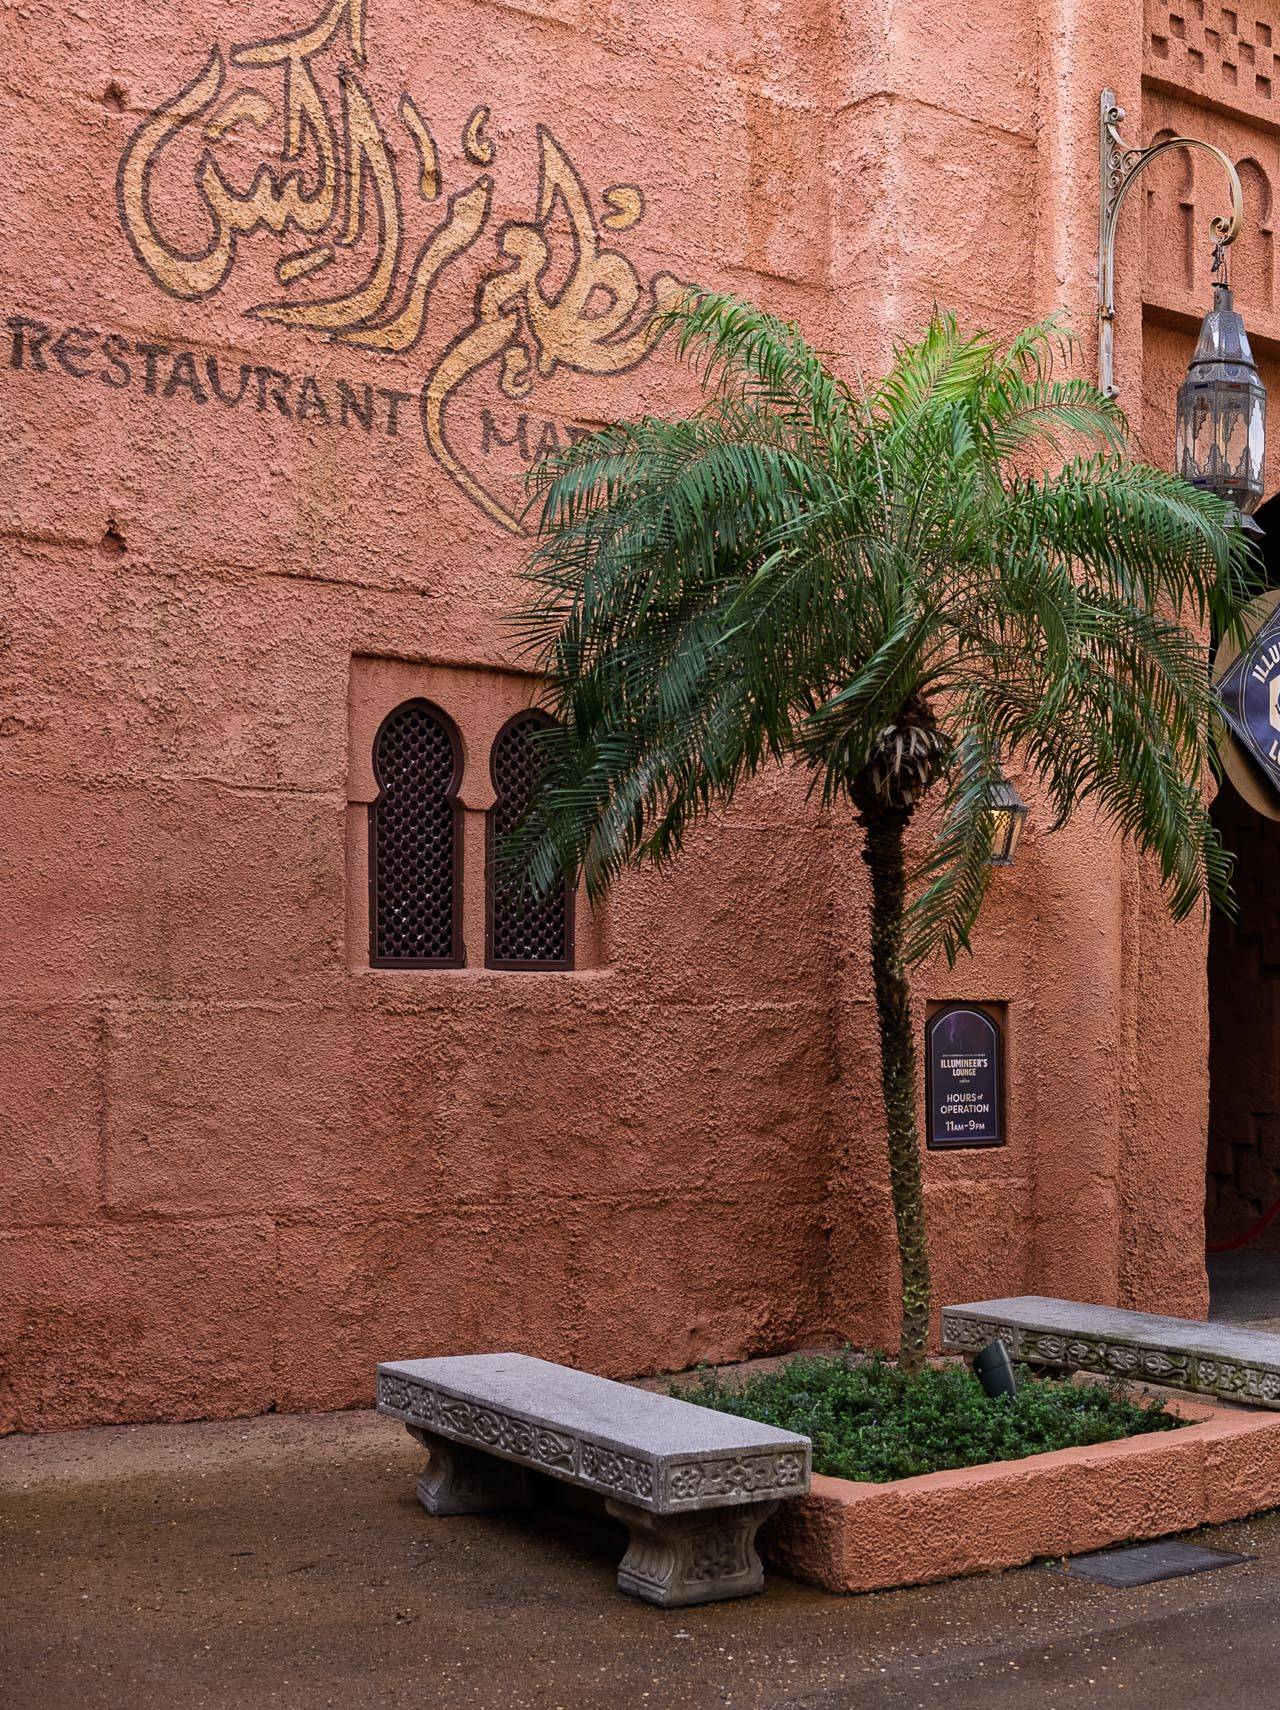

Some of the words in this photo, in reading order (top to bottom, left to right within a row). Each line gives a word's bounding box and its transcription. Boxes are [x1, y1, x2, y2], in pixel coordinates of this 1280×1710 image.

[4, 315, 415, 437] RESTAURANT
[940, 1059, 988, 1068] ILLUMINEER'S
[946, 1094, 976, 1102] HOURS
[940, 1104, 989, 1114] OPERATION
